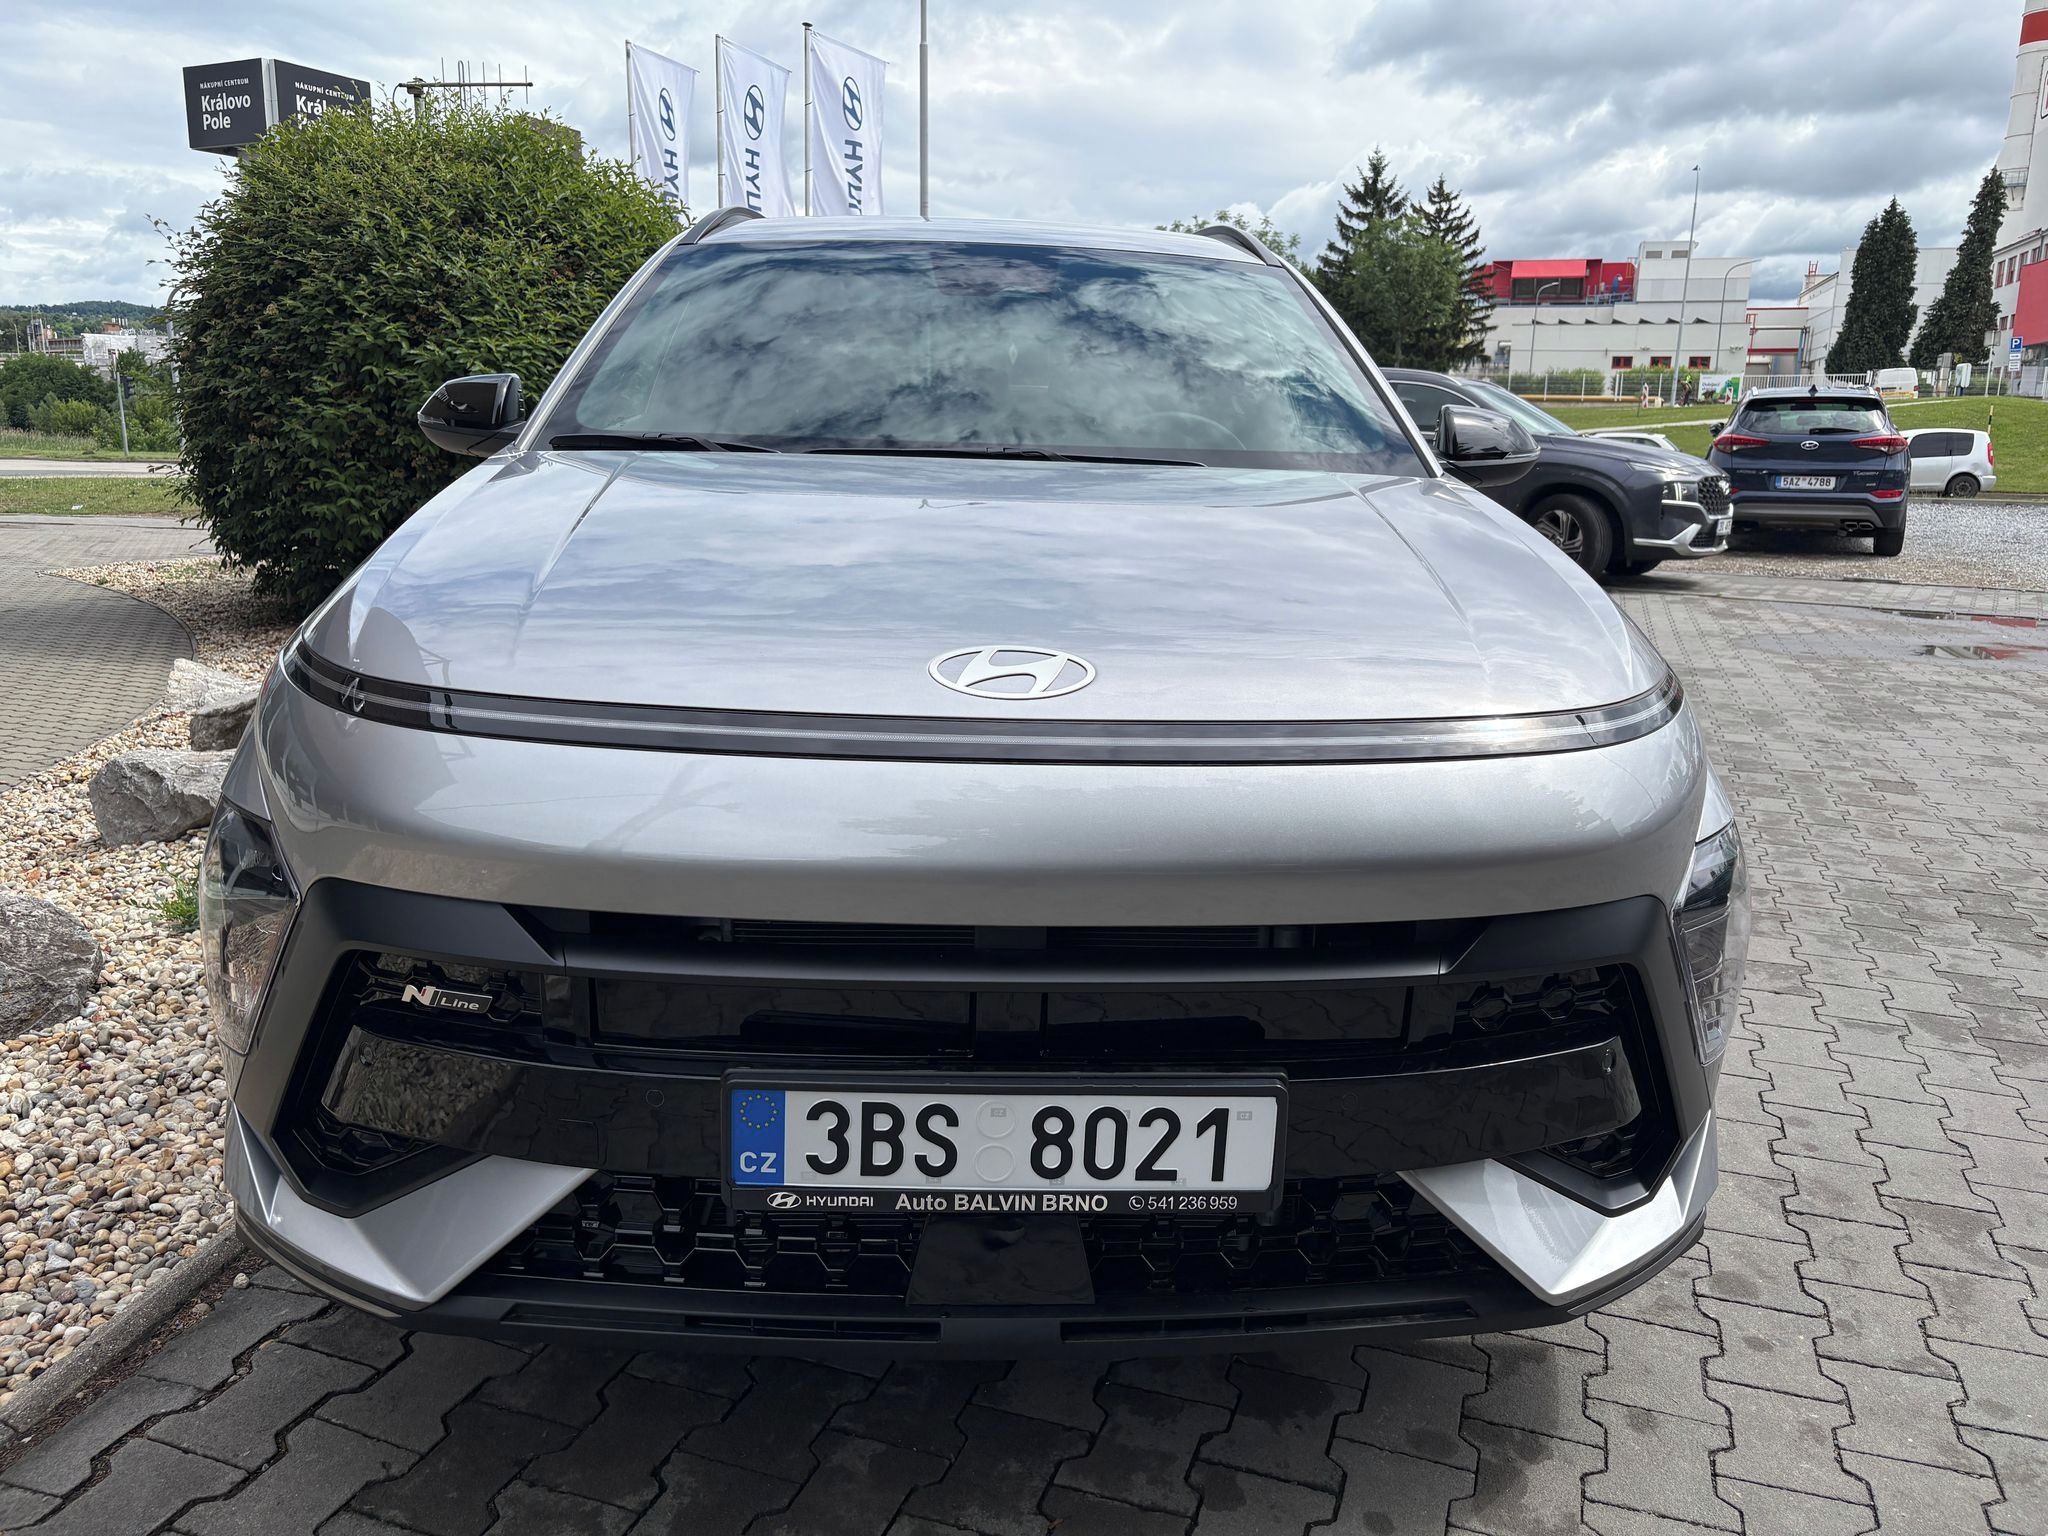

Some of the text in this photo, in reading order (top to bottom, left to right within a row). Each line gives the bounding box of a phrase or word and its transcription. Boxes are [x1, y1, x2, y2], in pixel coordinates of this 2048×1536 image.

[224, 77, 249, 87] CENTRUM
[201, 92, 251, 112] Královo
[202, 111, 231, 131] Pole
[2012, 338, 2020, 349] P
[1783, 477, 1801, 487] 5AZ
[440, 997, 480, 1010] Line
[805, 1100, 1230, 1182] 3BS 8021
[739, 1151, 777, 1174] CZ
[806, 1193, 1238, 1213] HYUNDAI Auto BALVIN BRNO 541 236 959
